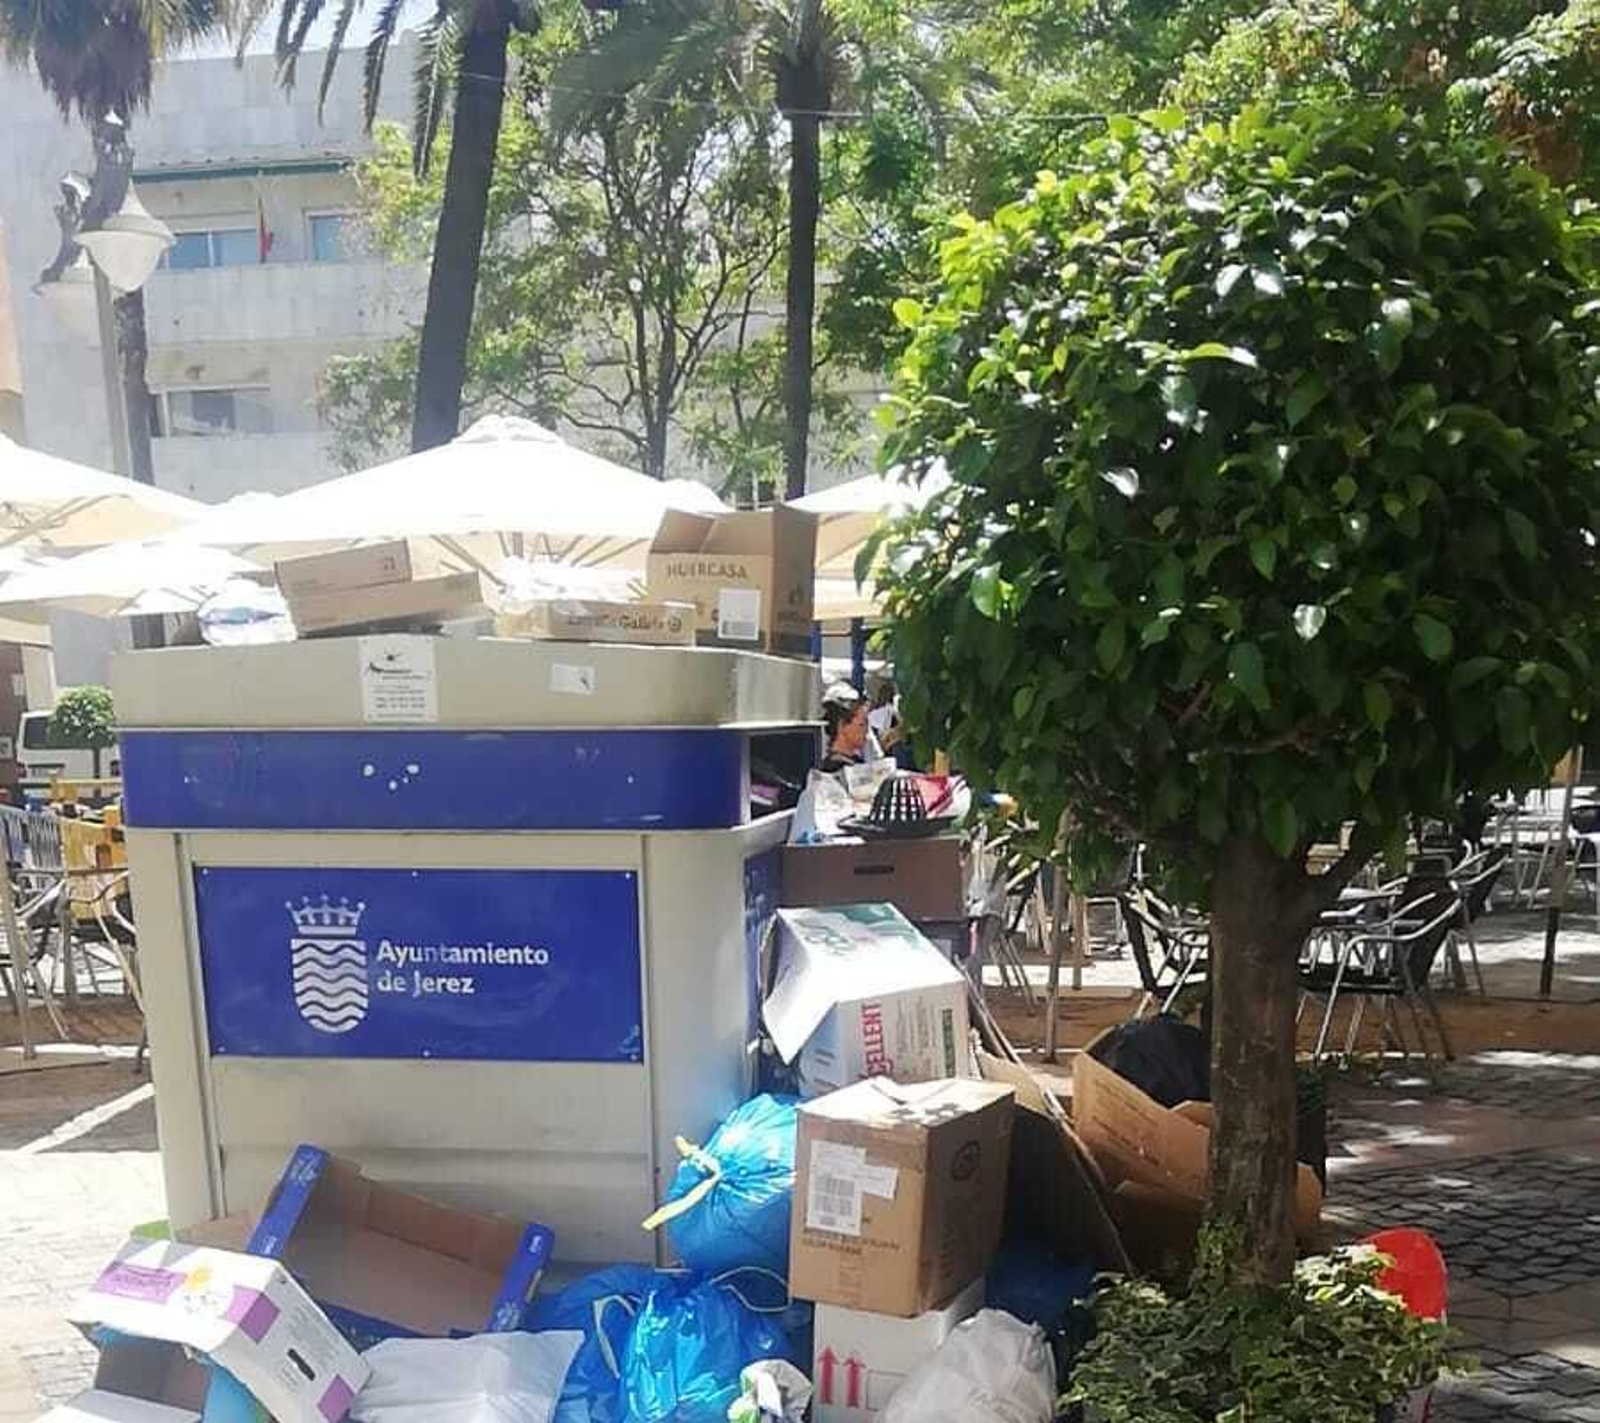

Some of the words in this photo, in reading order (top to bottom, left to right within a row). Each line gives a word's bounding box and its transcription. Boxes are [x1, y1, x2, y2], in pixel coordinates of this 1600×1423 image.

[667, 561, 748, 579] HUERCASA
[377, 939, 549, 968] Ayuntamiento
[377, 970, 407, 992] de
[412, 970, 475, 997] Jerez
